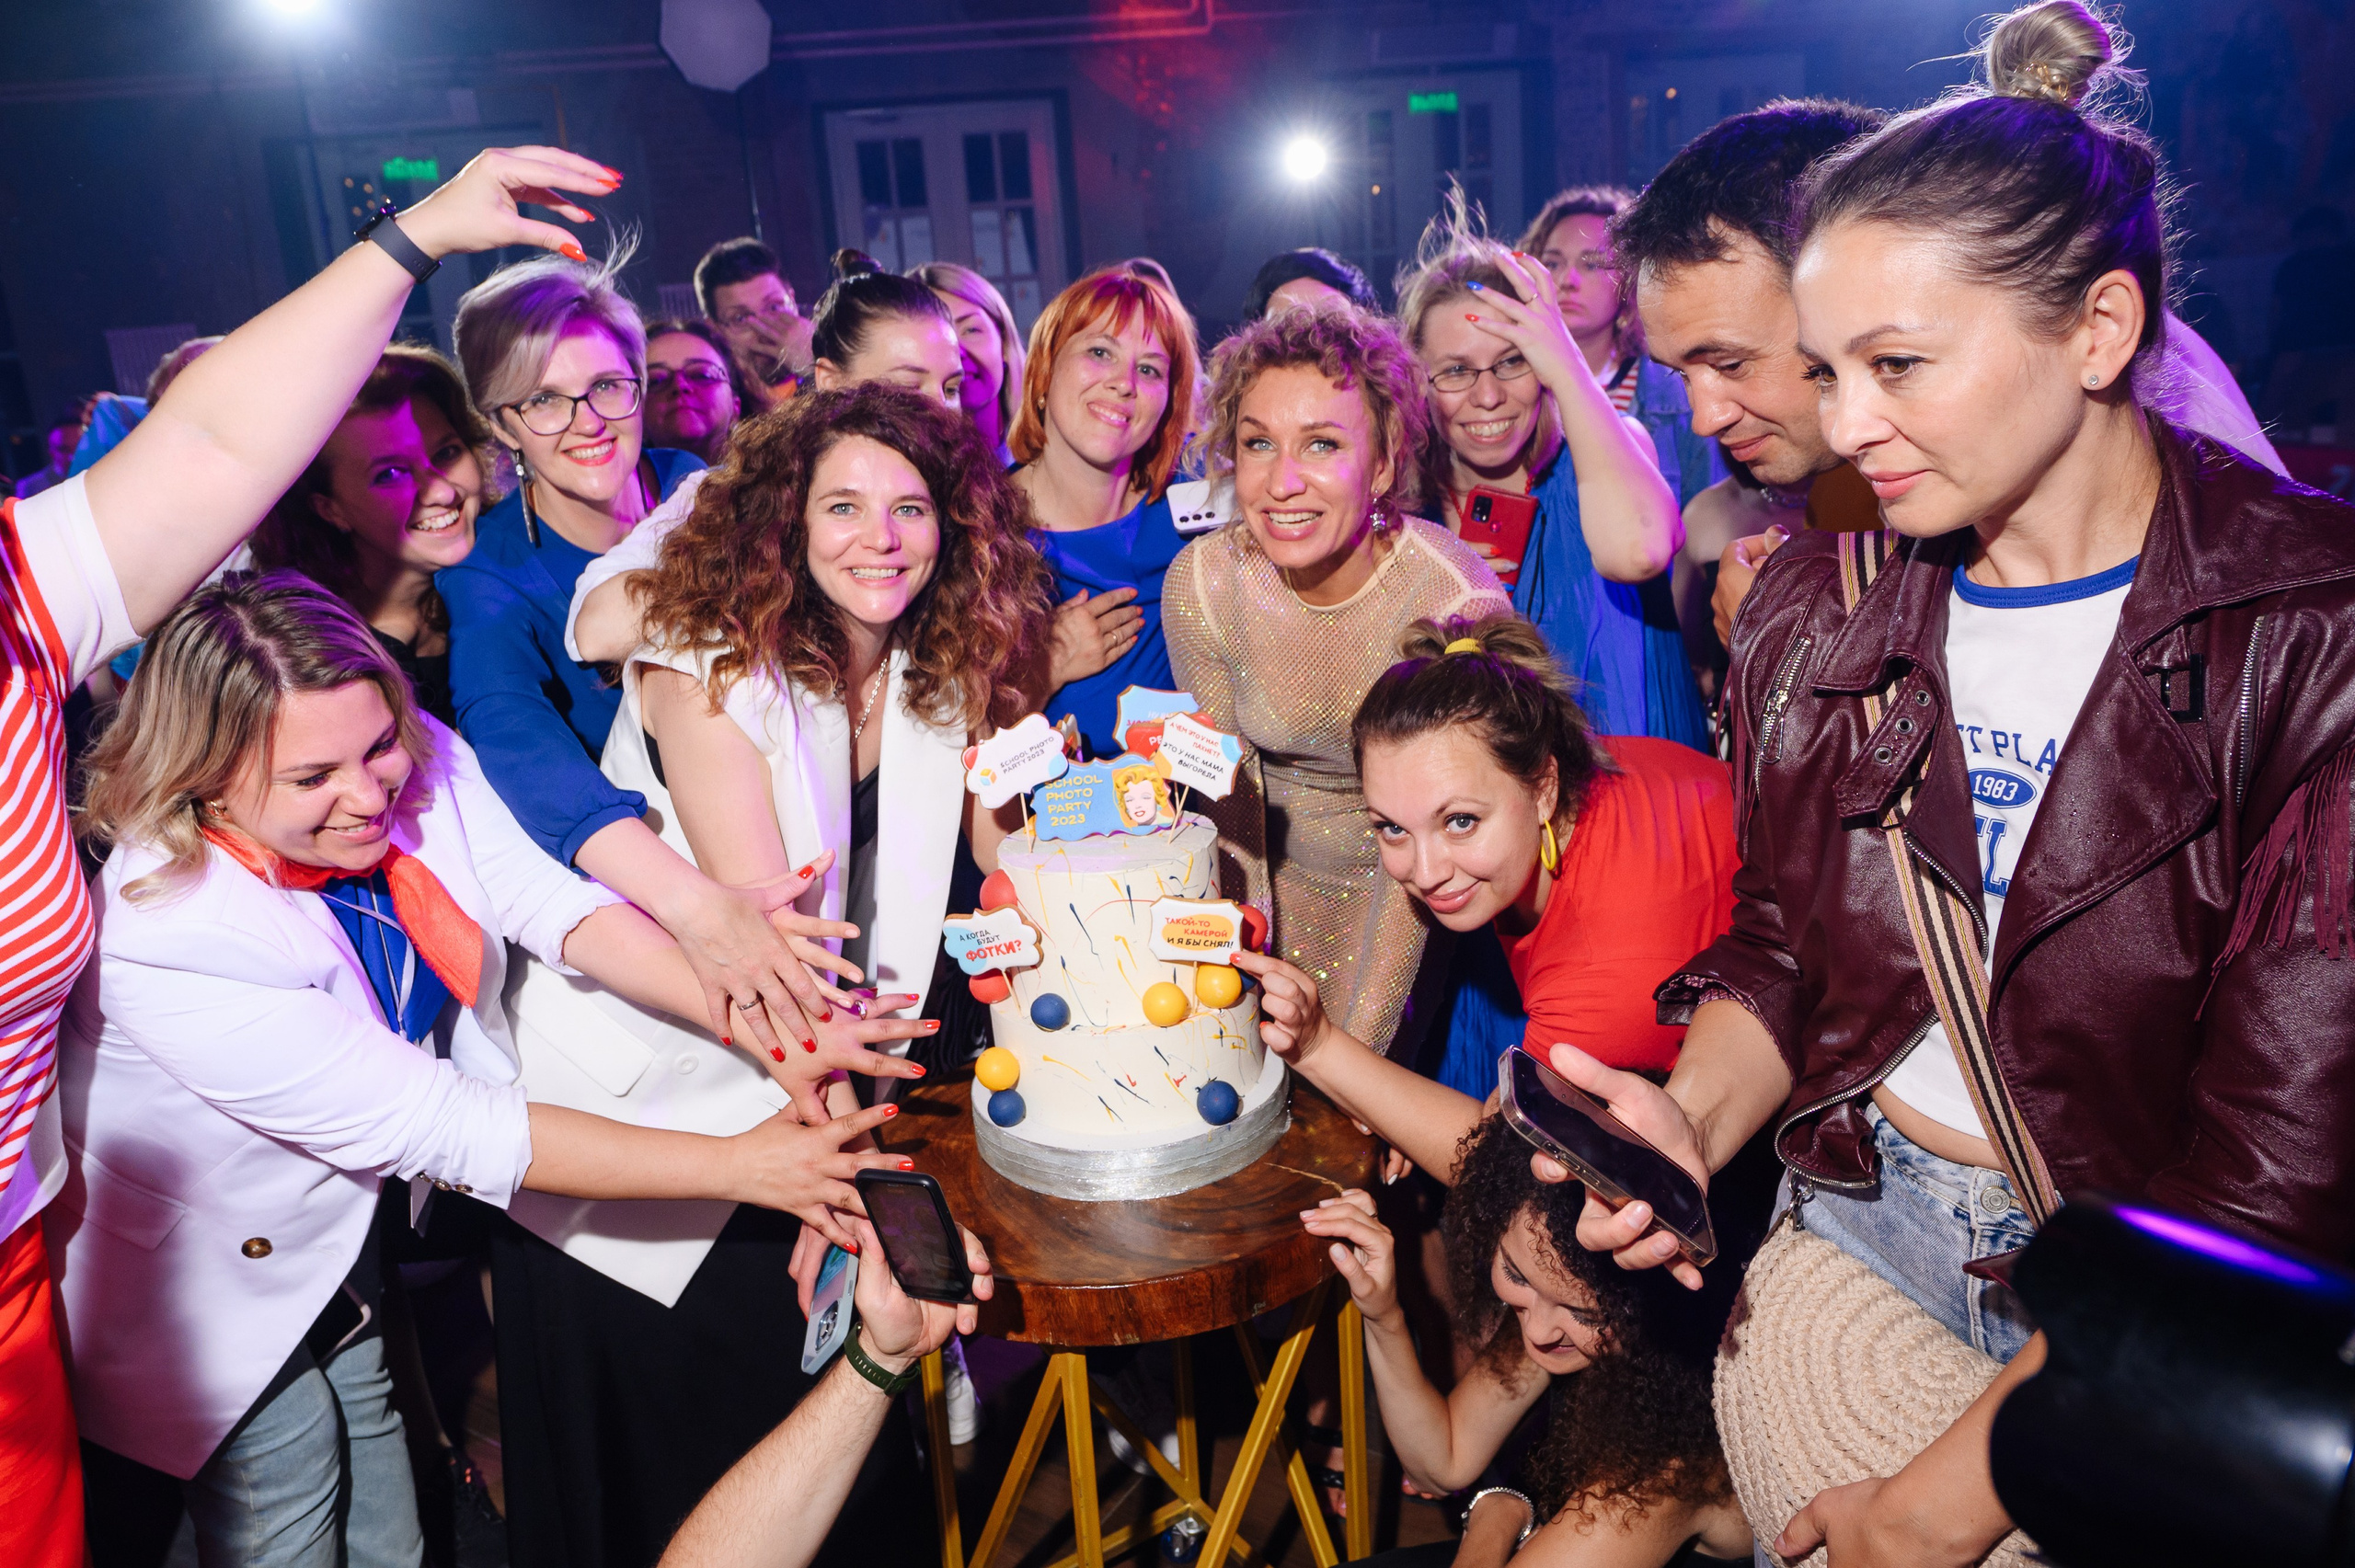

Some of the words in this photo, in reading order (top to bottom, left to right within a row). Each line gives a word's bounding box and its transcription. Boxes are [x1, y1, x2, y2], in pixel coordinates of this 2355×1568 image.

[1175, 724, 1188, 733] ЧЕМ
[1188, 729, 1200, 739] ЭТО
[1206, 737, 1219, 747] НАС
[1000, 750, 1028, 768] SCHOOL
[1028, 736, 1054, 752] PHOTO
[1163, 742, 1178, 752] ЭТО
[1184, 751, 1200, 763] НАС
[1200, 760, 1224, 773] МАМА
[1990, 730, 2058, 775] PLA
[1003, 758, 1026, 774] PARTY
[1027, 748, 1045, 761] 2023
[1178, 759, 1216, 781] ВЫГОРЕЛА
[1044, 774, 1103, 790] SCHOOL
[1972, 773, 2019, 802] 1983
[1045, 787, 1094, 802] PHOTO
[1047, 800, 1092, 814] PARTY
[1050, 813, 1086, 827] 2023
[1165, 917, 1211, 928] ТАКОЙ-ТО
[966, 929, 991, 941] КОГДА
[976, 934, 1000, 945] БУДУТ
[1184, 928, 1228, 938] КАМЕРОЙ
[965, 939, 1022, 962] ФОТКИ?
[1185, 938, 1201, 946] БЫ
[1203, 939, 1234, 949] СНЯЛ!
